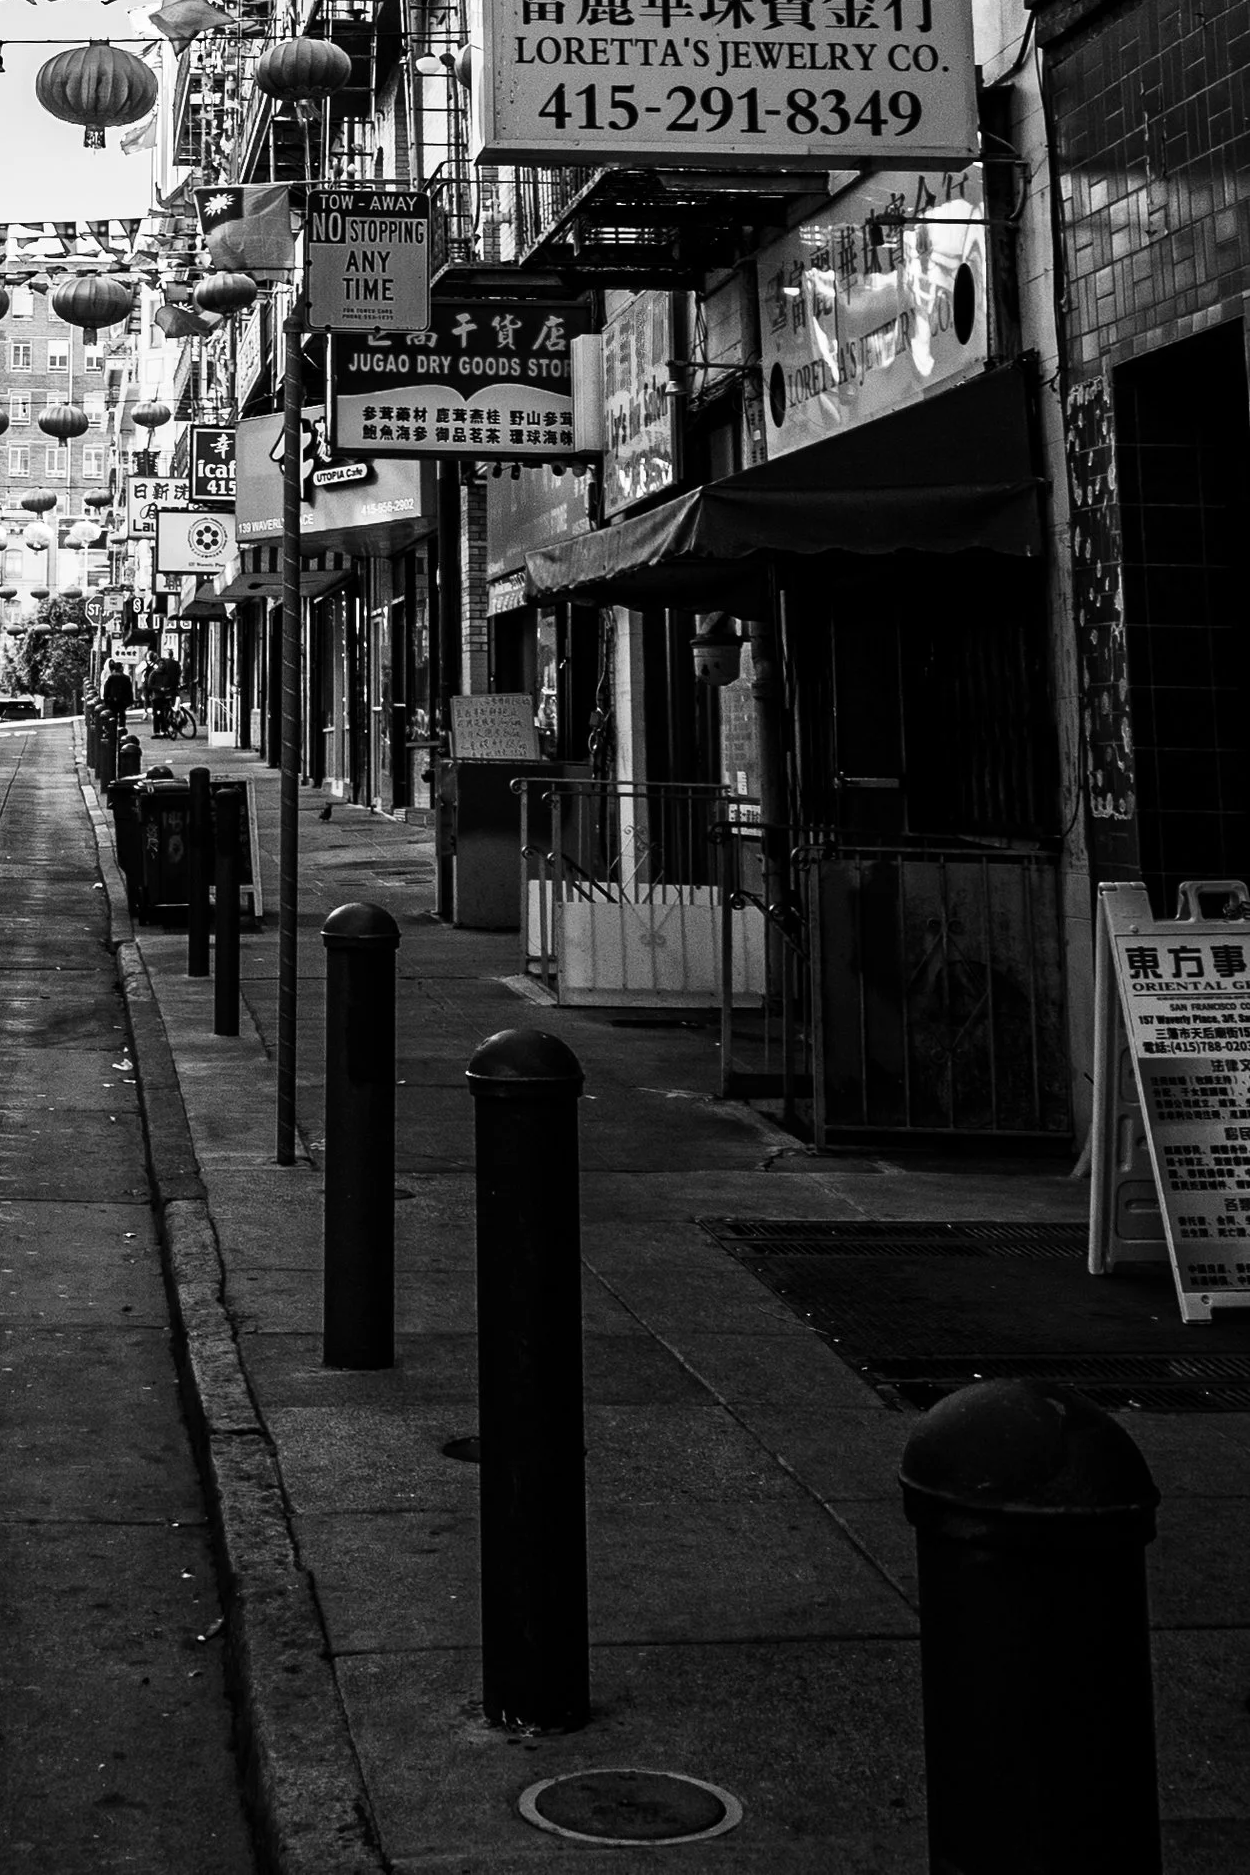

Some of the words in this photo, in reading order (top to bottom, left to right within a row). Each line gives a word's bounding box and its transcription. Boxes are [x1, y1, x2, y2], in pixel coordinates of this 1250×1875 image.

[514, 35, 710, 67] LORETTA'S
[715, 41, 878, 76] JEWELRY
[887, 44, 949, 73] CO.
[538, 82, 923, 137] 415-291-8349
[319, 194, 354, 210] TOW
[369, 195, 418, 212] AWAY
[312, 212, 342, 242] NO
[350, 219, 425, 244] STOPPING
[345, 250, 391, 274] ANY
[342, 277, 394, 302] TIME
[348, 353, 410, 373] JUGAO
[417, 355, 452, 374] DRY
[459, 356, 521, 376] GOODS
[316, 470, 345, 483] UTOPIA
[1125, 944, 1248, 980] 東方事
[1132, 980, 1228, 992] ORIENTAL
[1169, 1003, 1188, 1011] SAN
[1190, 1002, 1238, 1011] FRANCISCO
